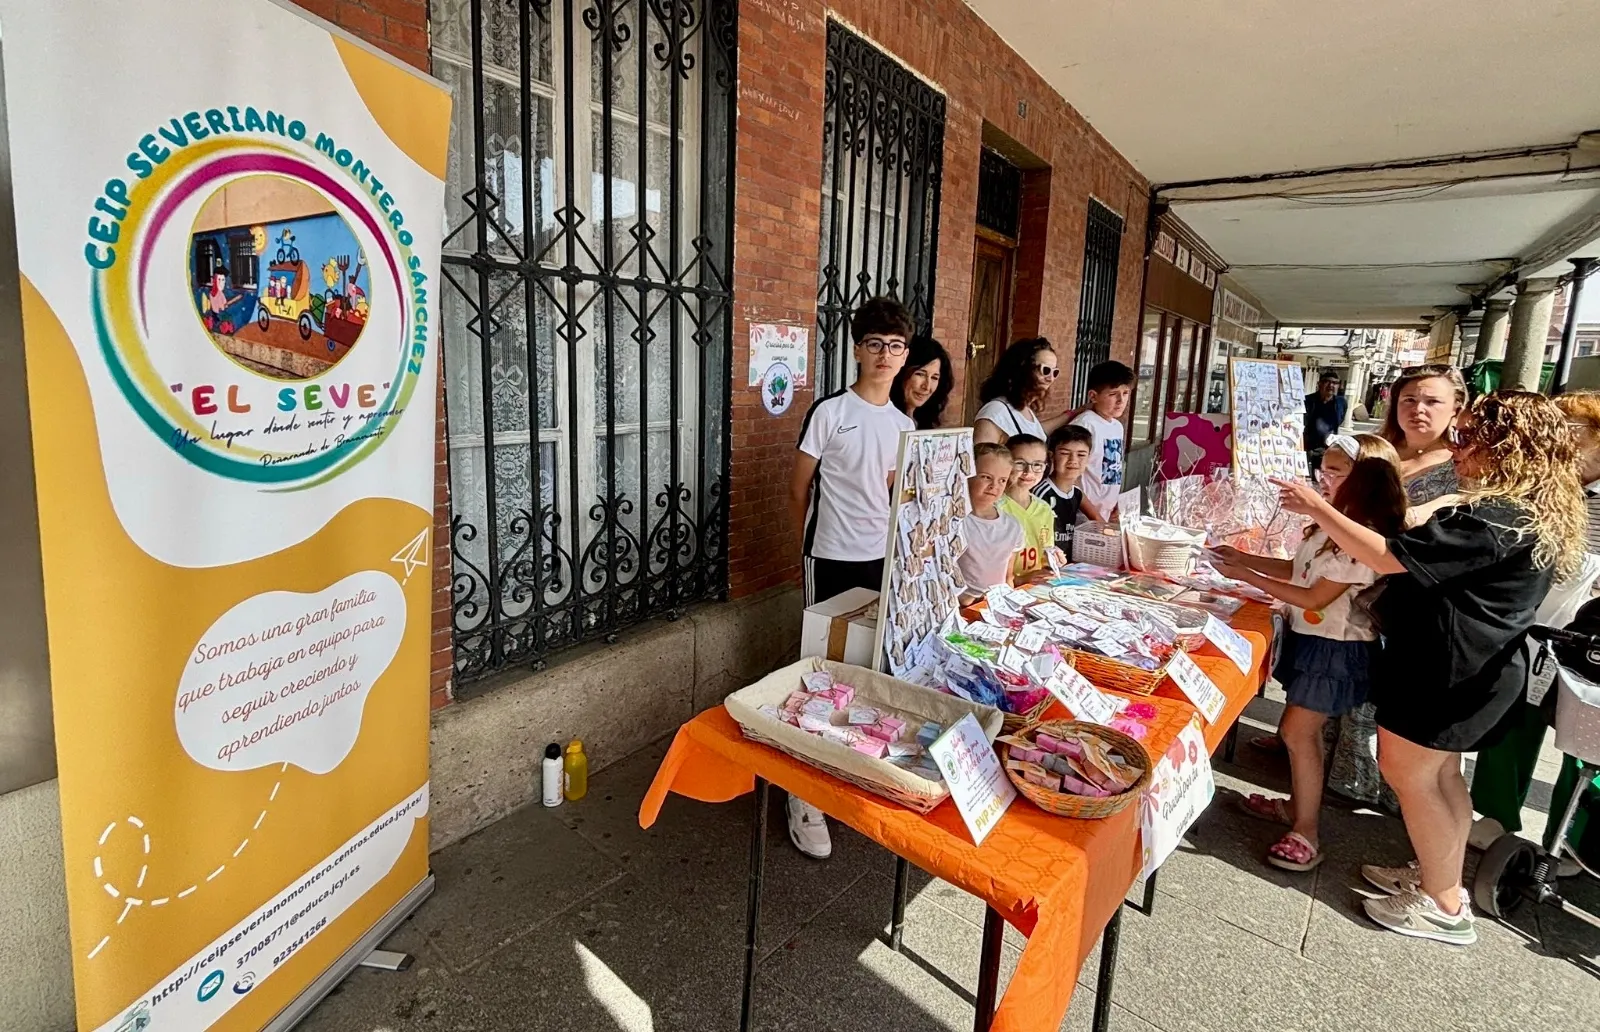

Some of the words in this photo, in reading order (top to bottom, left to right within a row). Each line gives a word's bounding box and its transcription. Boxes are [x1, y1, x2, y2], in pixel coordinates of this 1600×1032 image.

[85, 178, 129, 269] CEIP
[127, 106, 306, 178] SEVERIANO
[315, 132, 413, 248] MONTERO
[407, 254, 428, 375] SÁNCHEZ
[211, 420, 254, 448] lugar
[308, 408, 336, 429] sentir
[343, 414, 354, 430] y
[359, 401, 405, 424] aprender
[260, 442, 318, 468] Peñaranda
[320, 438, 331, 450] de
[1020, 547, 1037, 570] 19
[178, 683, 216, 713] que
[218, 656, 285, 692] trabaja
[287, 648, 307, 664] en
[308, 629, 352, 658] equipo
[351, 615, 386, 641] para
[194, 632, 260, 665] Somos
[261, 622, 294, 642] una
[295, 606, 329, 636] gran
[330, 588, 377, 621] familia
[217, 700, 320, 762] aprendiendo
[318, 679, 361, 716] juntos
[221, 690, 278, 724] seguir
[280, 656, 346, 698] creciendo
[347, 653, 359, 671] y
[151, 793, 423, 1007] http://ceipseverianomontero.centros.educa.jcyl.es/
[236, 864, 361, 969] 37008771@educa.jcyl.es
[273, 916, 327, 967] 923541268
